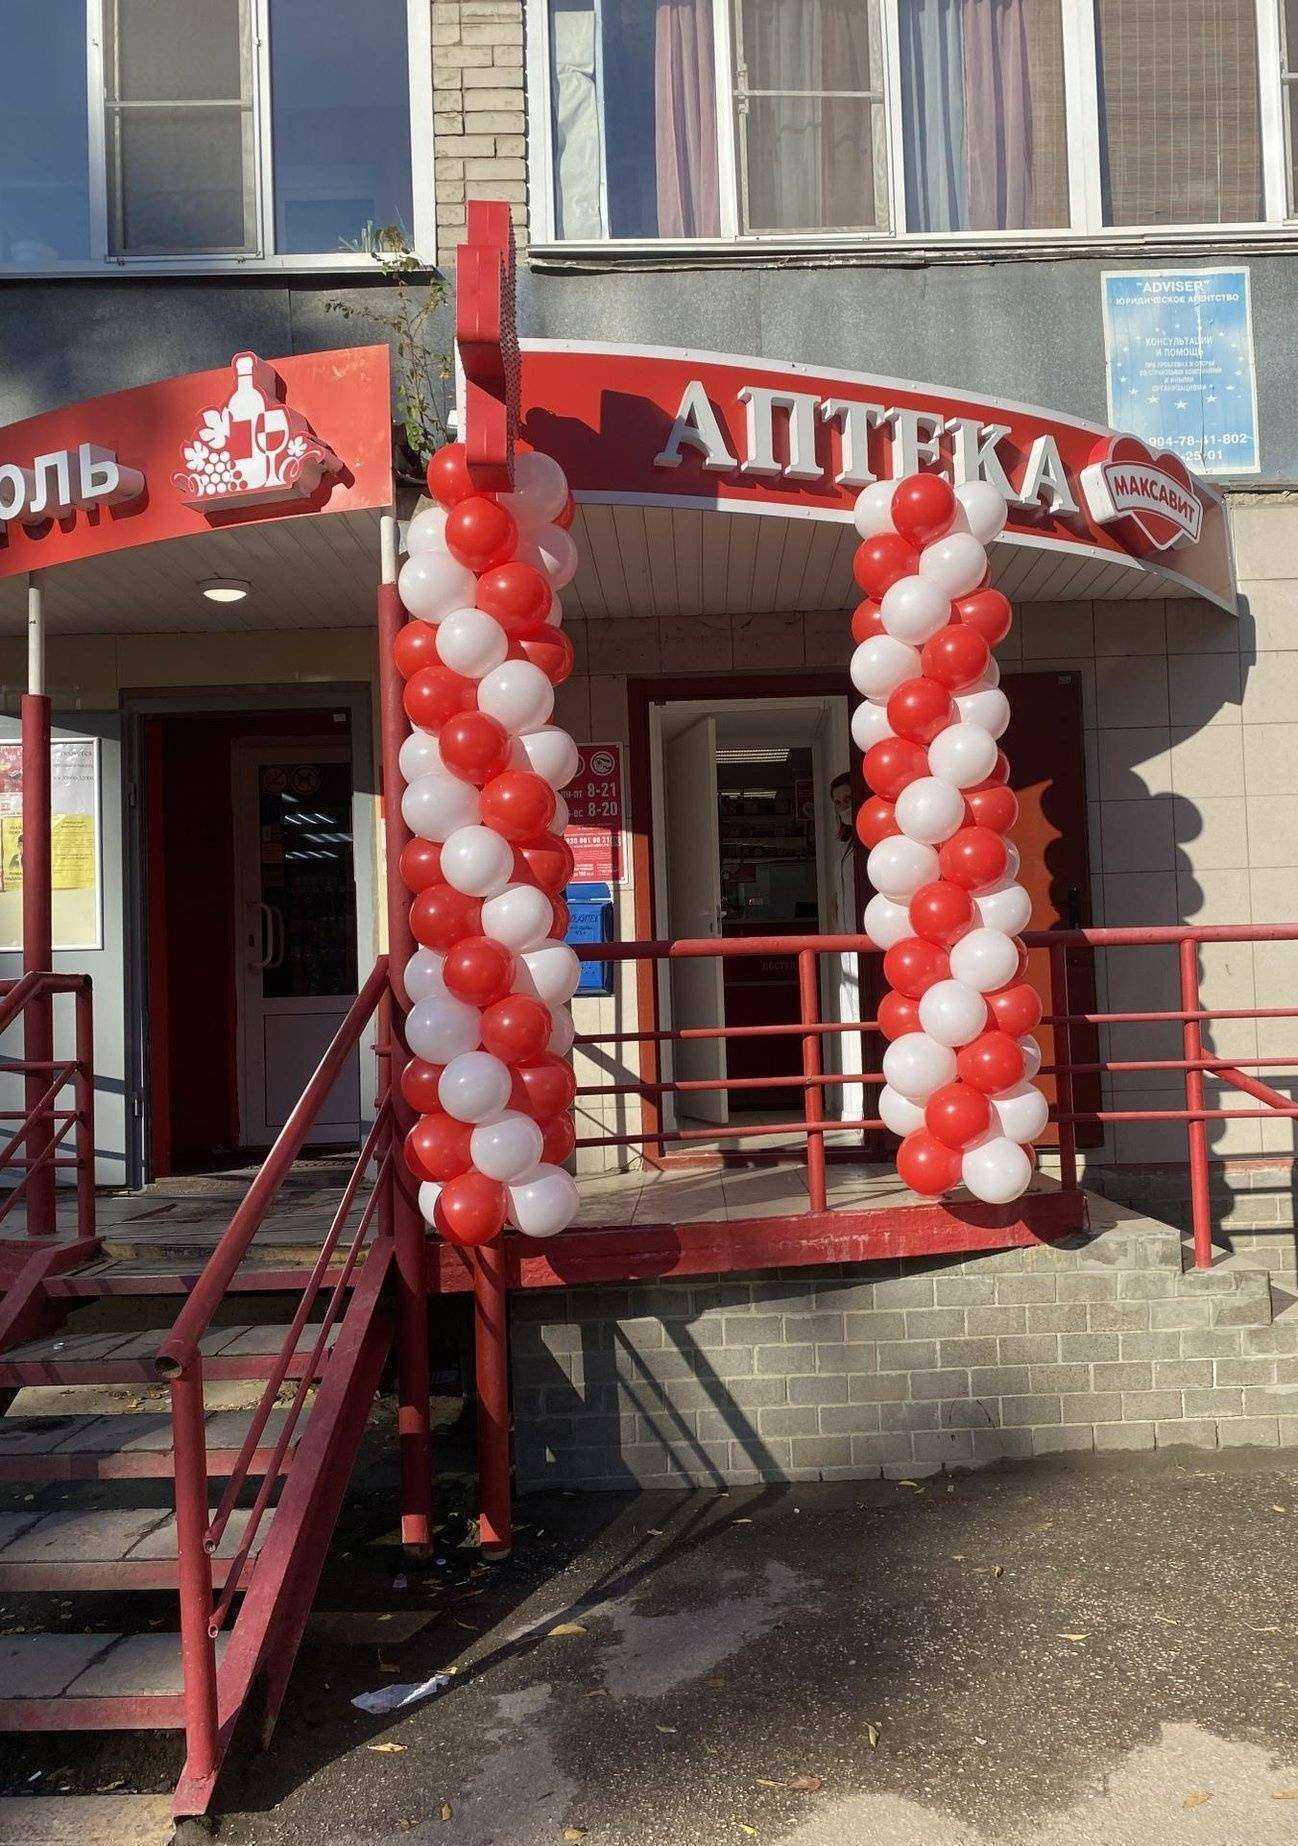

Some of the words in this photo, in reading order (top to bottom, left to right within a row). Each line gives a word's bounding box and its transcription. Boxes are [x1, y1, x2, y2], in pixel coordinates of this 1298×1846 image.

[654, 380, 1080, 516] АПТЕКА
[0, 443, 120, 521] ОЛЬ
[1113, 475, 1196, 523] МАКСАВИТ
[587, 782, 616, 798] 8-21
[587, 802, 618, 817] 8-20
